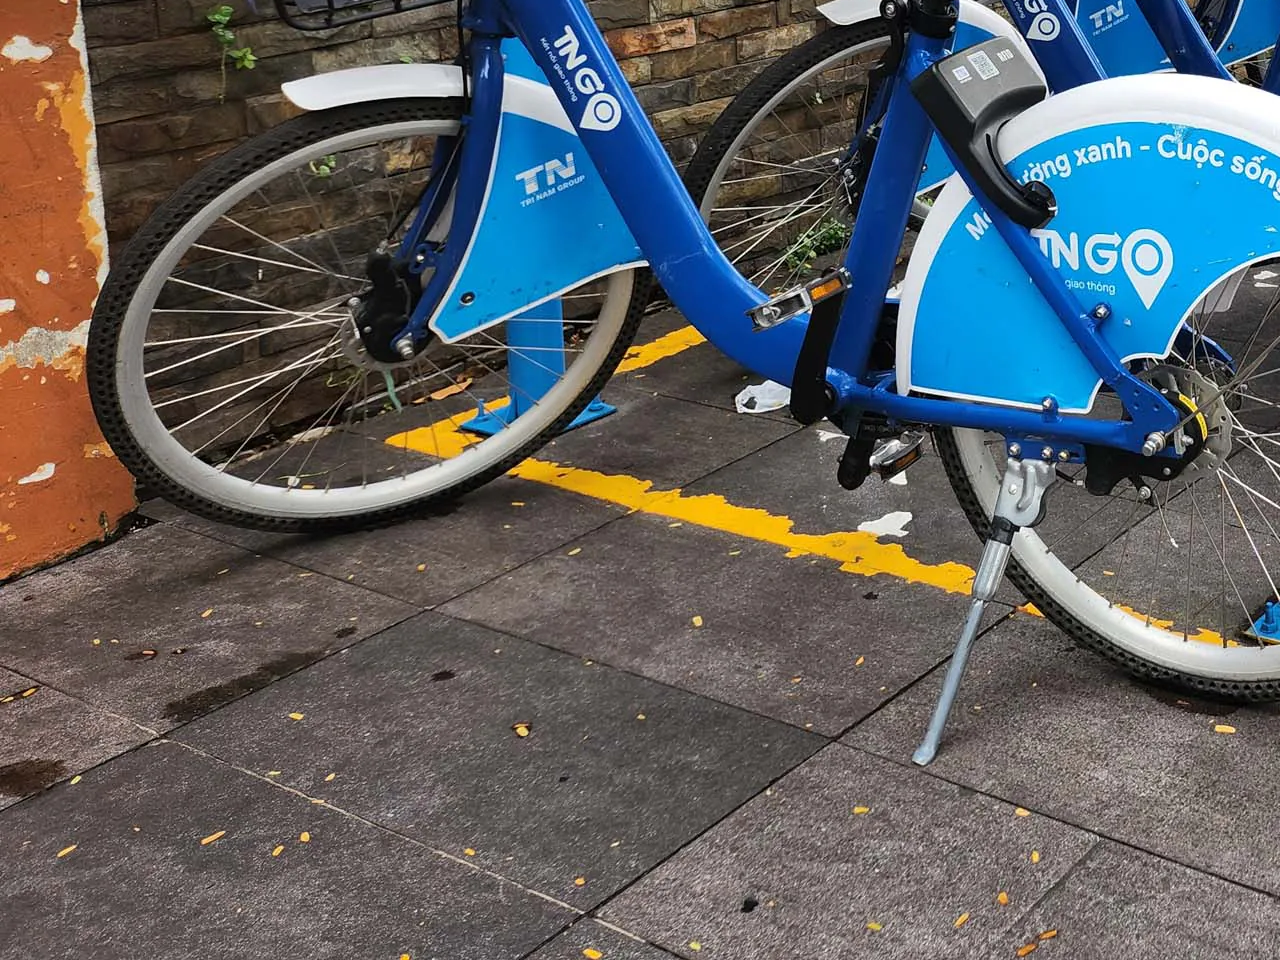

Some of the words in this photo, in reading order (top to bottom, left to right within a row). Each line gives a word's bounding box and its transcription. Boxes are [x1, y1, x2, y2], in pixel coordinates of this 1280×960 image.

[1089, 0, 1124, 29] TN
[554, 25, 621, 131] TNGO
[1074, 136, 1131, 166] xanh
[1157, 134, 1224, 168] Cuộc
[515, 152, 576, 195] TN
[557, 175, 585, 191] GROUP
[1065, 279, 1085, 289] giao
[1087, 280, 1116, 295] thông
